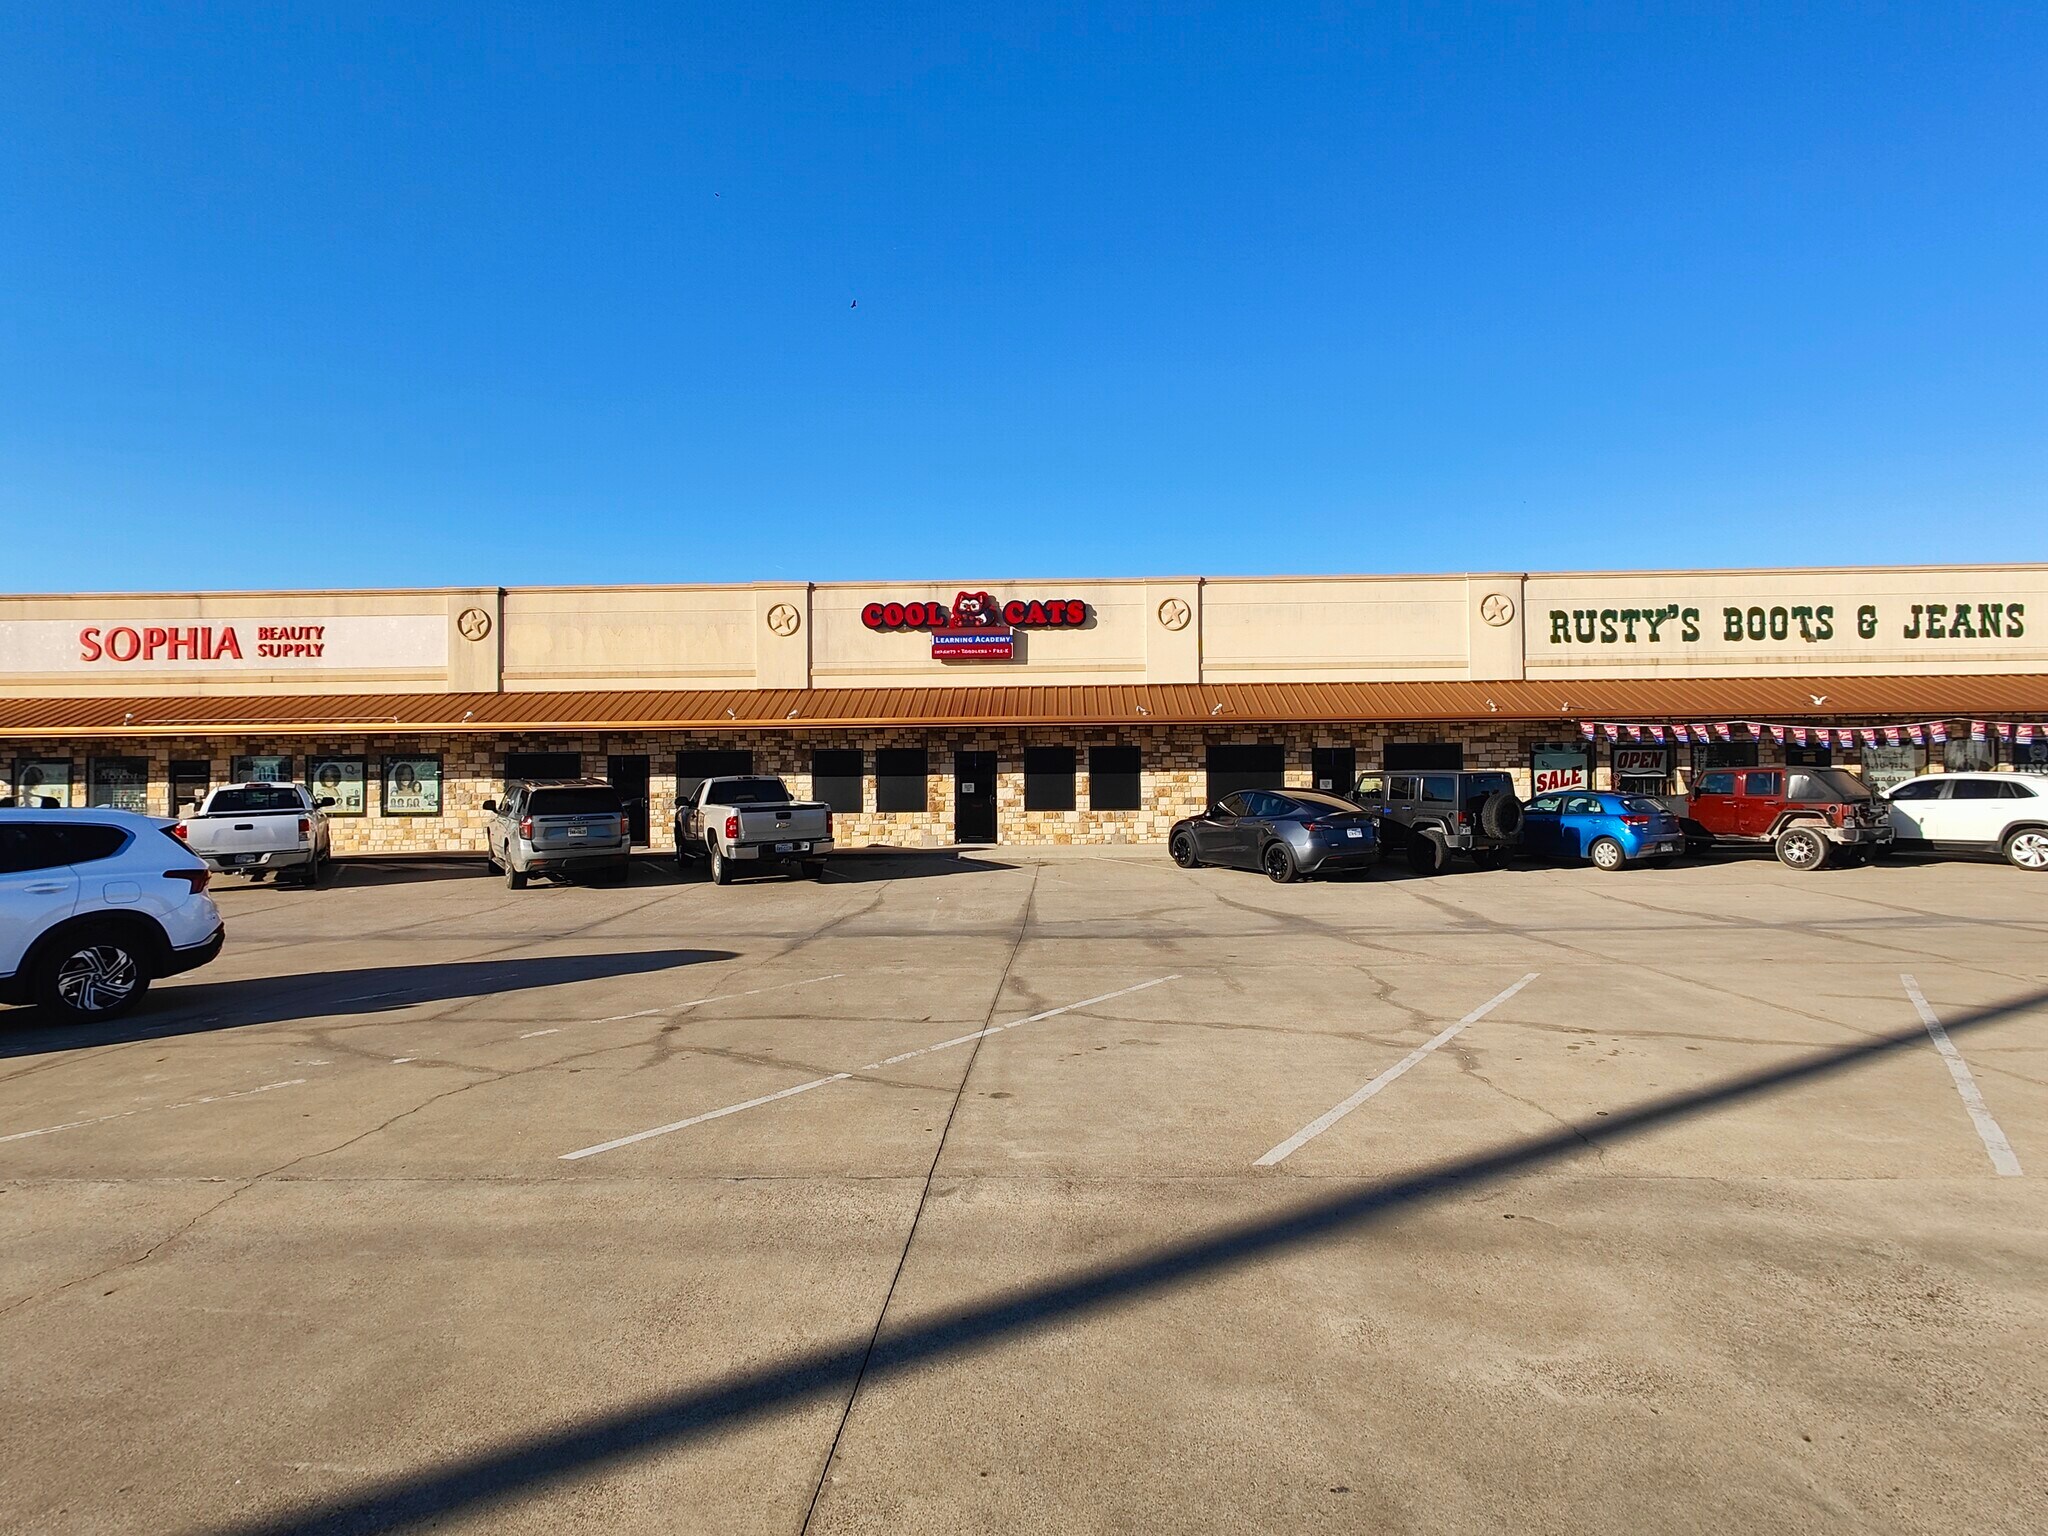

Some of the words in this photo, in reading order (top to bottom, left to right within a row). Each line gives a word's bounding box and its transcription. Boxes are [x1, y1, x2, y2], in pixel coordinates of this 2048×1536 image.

[861, 602, 945, 629] COOL
[1003, 600, 1087, 627] CATS
[1549, 604, 1700, 643] RUSTY'S
[1723, 606, 1833, 642] BOOTS
[1857, 604, 1878, 640] &
[1903, 603, 2025, 639] JEANS
[79, 626, 243, 662] SOPHIA
[257, 626, 326, 641] BEAUTY
[935, 636, 973, 644] LEARNING
[257, 643, 326, 657] SUPPLY
[1617, 752, 1664, 769] OPEN
[1536, 765, 1583, 793] SALE
